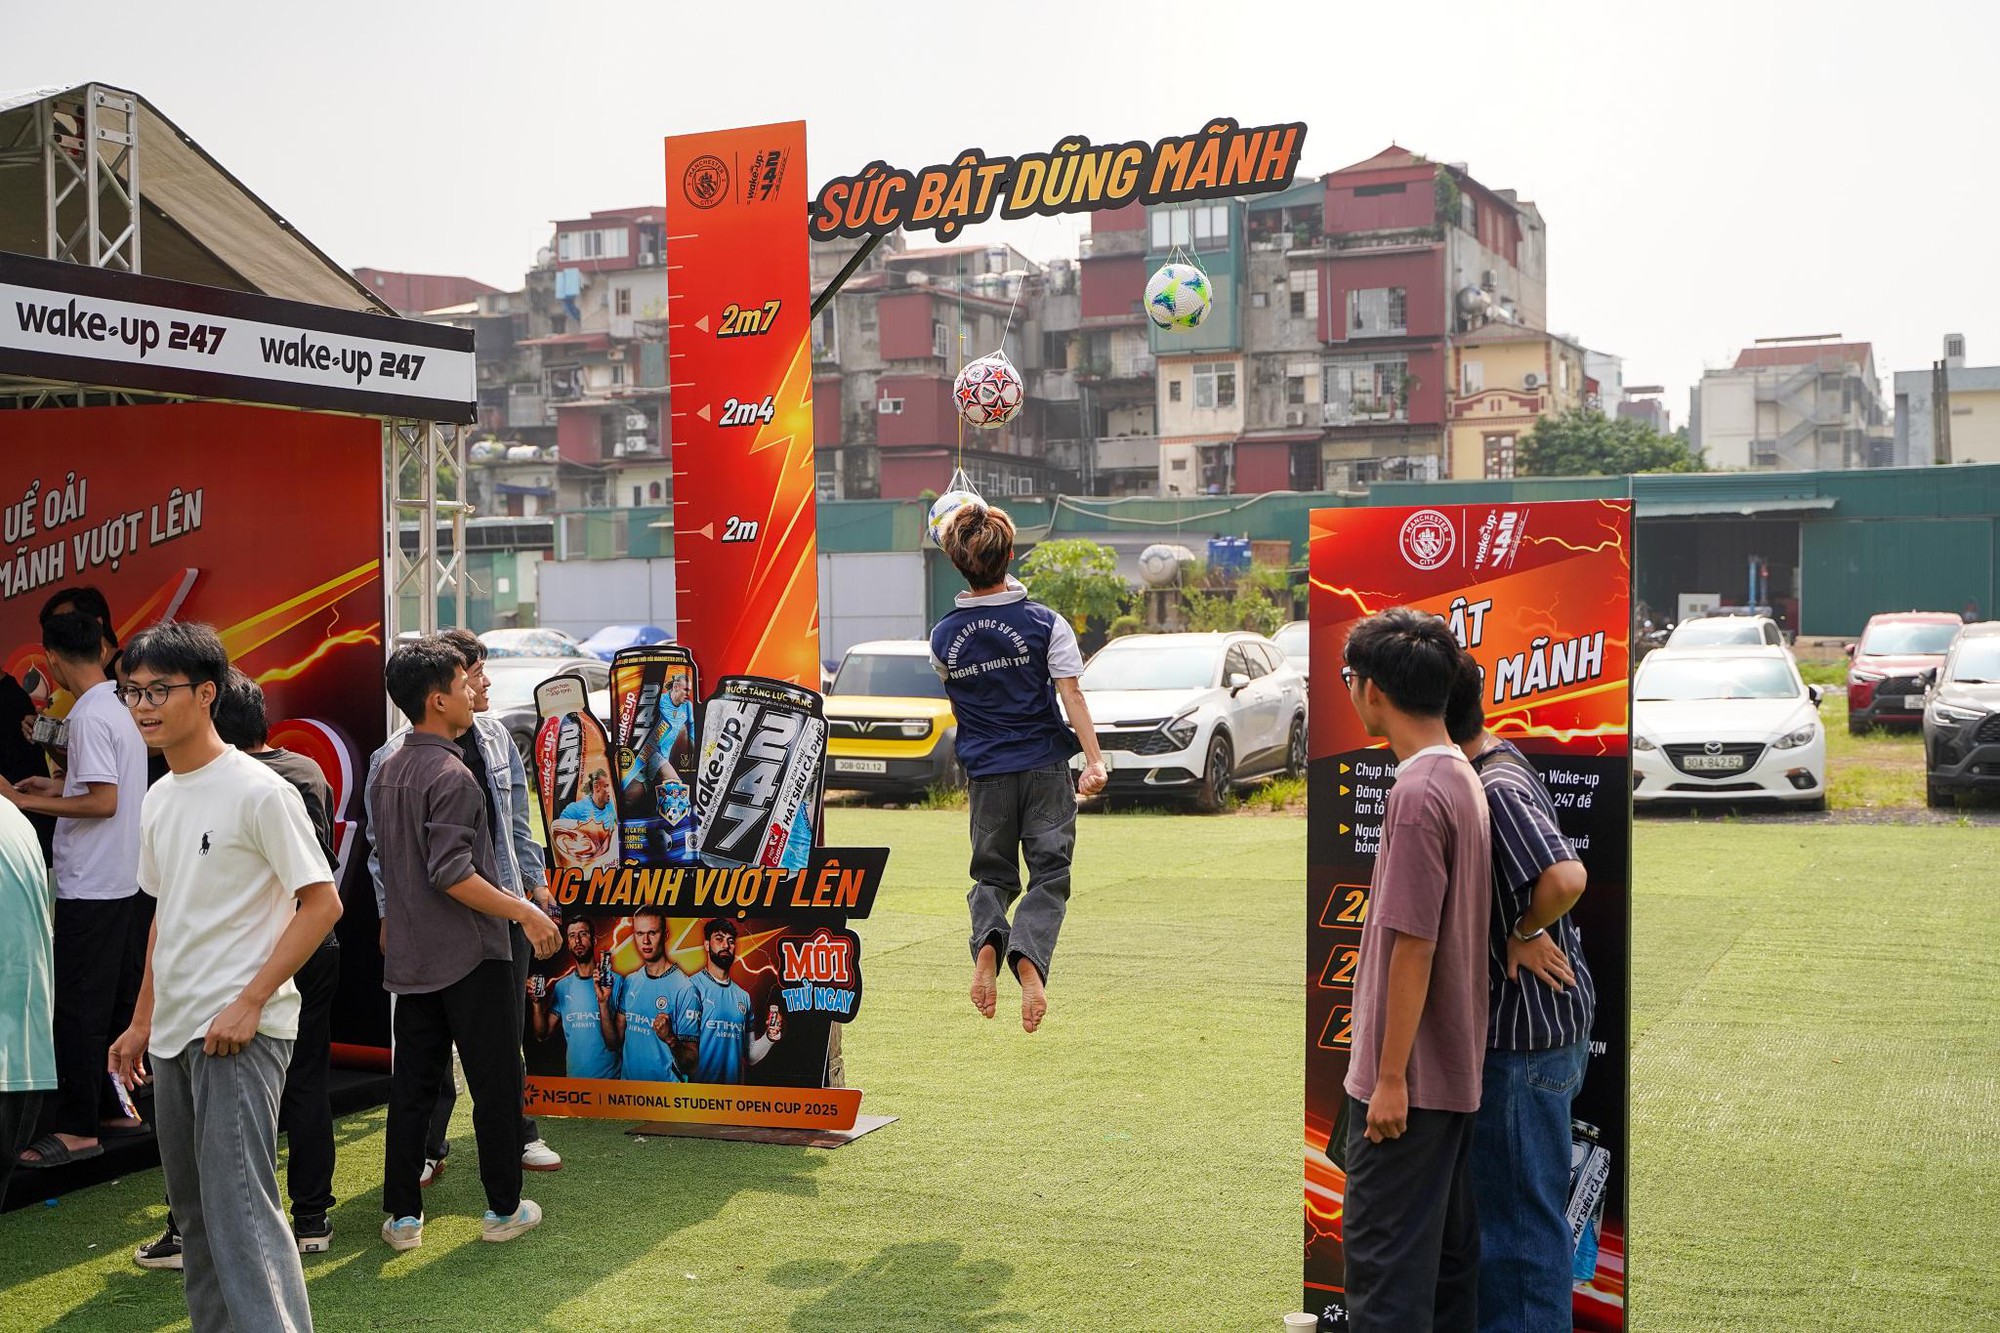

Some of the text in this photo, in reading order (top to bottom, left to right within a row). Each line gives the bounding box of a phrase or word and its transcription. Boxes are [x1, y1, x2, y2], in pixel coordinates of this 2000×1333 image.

[688, 158, 725, 178] MANCHESTER
[760, 150, 781, 201] 247
[816, 167, 905, 232] SỨC
[911, 157, 1004, 234] BẬT
[1009, 143, 1141, 211] DŨNG
[1149, 124, 1297, 194] MÃNH
[700, 198, 714, 206] CITY
[717, 300, 781, 338] 2m7
[168, 321, 227, 355] 247
[379, 351, 425, 381] 247
[719, 396, 775, 427] 2m4
[4, 470, 87, 544] UỂ OẢI
[72, 511, 144, 570] VƯỢT
[150, 486, 203, 546] LÊN
[722, 516, 758, 543] 2m
[1406, 514, 1449, 534] MANCHESTER
[1489, 512, 1518, 567] 247
[1419, 558, 1436, 566] CITY
[947, 618, 1029, 669] TRƯỜNG ĐẠI HỌC SƯ PHẠM
[949, 663, 980, 680] NGHỆ
[1013, 655, 1030, 667] TW
[1493, 630, 1604, 704] MÃNH
[715, 710, 801, 852] 247
[1355, 762, 1382, 779] Chụp
[1549, 769, 1600, 788] Wake-up
[1355, 801, 1371, 814] lan
[1356, 784, 1382, 802] Đăng
[1554, 791, 1594, 808] 247 để
[1355, 823, 1381, 840] Ngườ
[585, 859, 684, 906] MÃNH
[695, 862, 788, 920] VƯỢT
[790, 858, 866, 908] LÊN
[782, 934, 848, 982] MỚI
[782, 979, 855, 1014] THỬ NGAY
[542, 1089, 838, 1116] NSOC NATIONAL STUDENT OPEN CUP 2025
